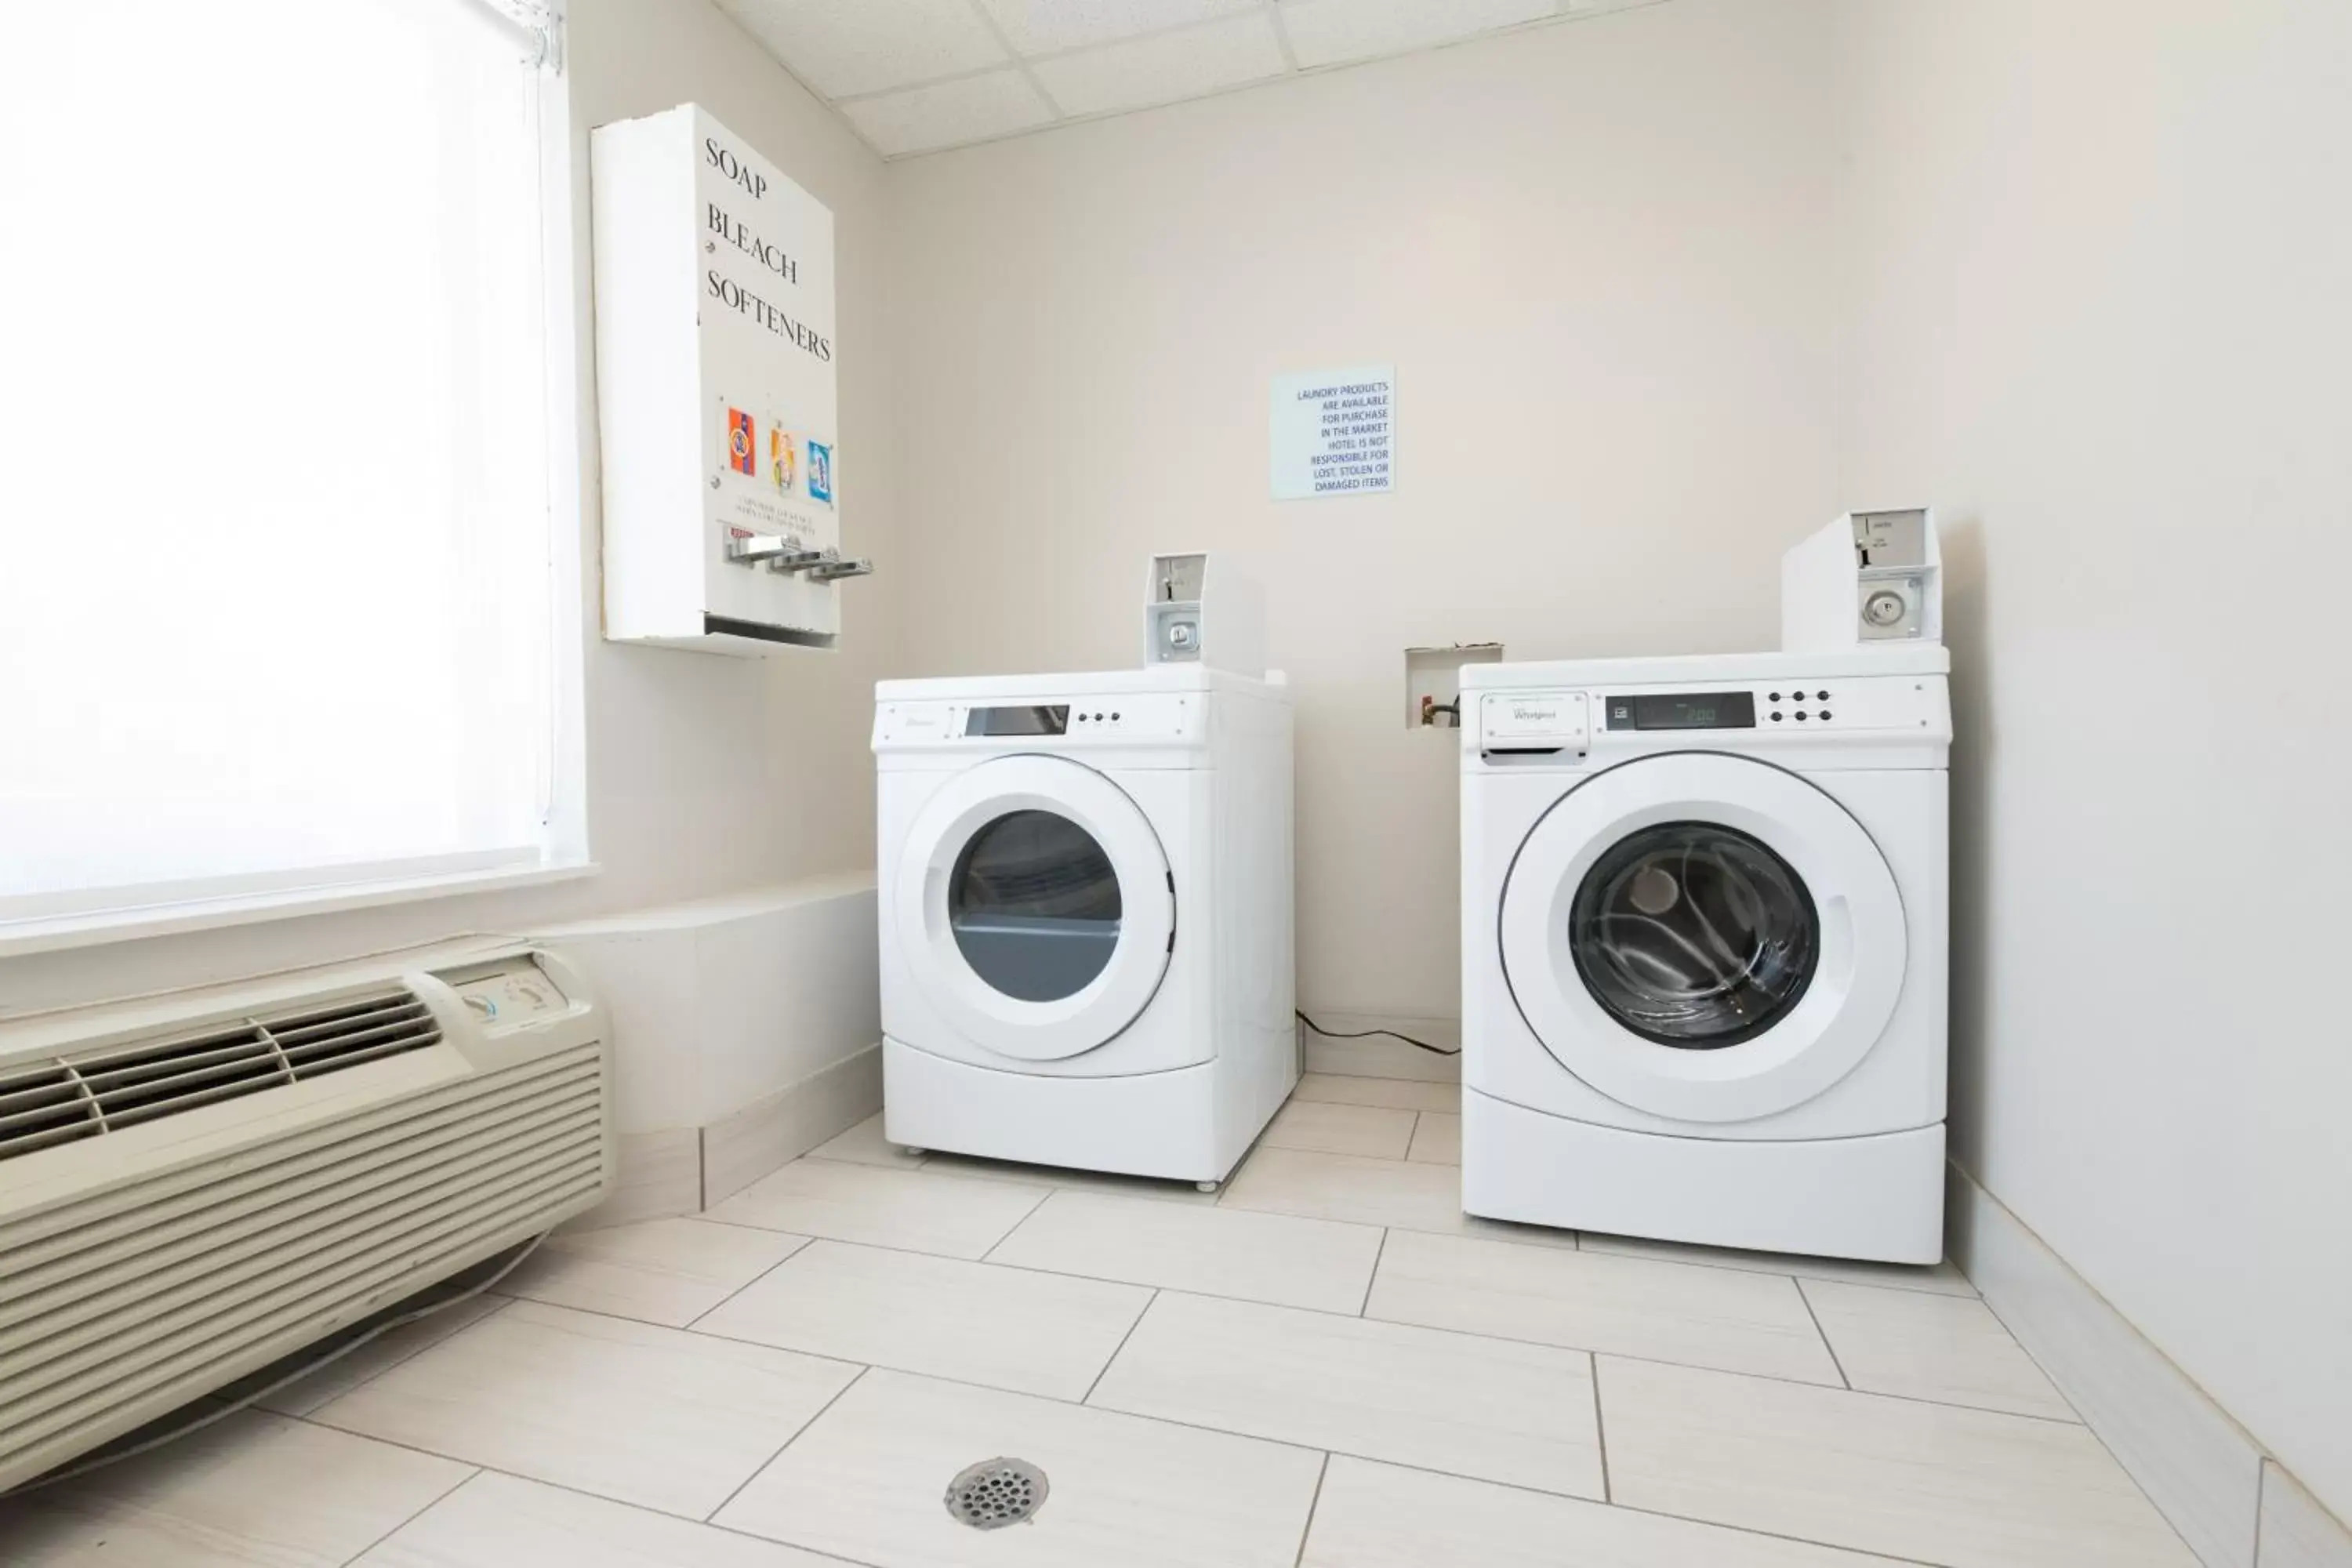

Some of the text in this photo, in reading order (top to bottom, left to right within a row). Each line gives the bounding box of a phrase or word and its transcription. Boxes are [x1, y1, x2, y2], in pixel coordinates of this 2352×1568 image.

[706, 136, 767, 198] SOAP
[708, 202, 797, 285] BLEACH
[707, 269, 831, 362] SOFTENERS
[1298, 381, 1389, 401] LAUNDRY PRODUCTS
[1323, 395, 1388, 410] ARE AVAILABLE
[1323, 408, 1388, 424] FOR PURCHASE
[1322, 423, 1388, 437] IN THE MARKET
[1328, 436, 1388, 450] HOTEL IS NOT
[1311, 449, 1388, 466] RESPONSIBLE FOR
[1340, 464, 1373, 477] STOLEN
[1375, 463, 1388, 473] OR
[1316, 476, 1388, 492] DAMAGED ITEMS
